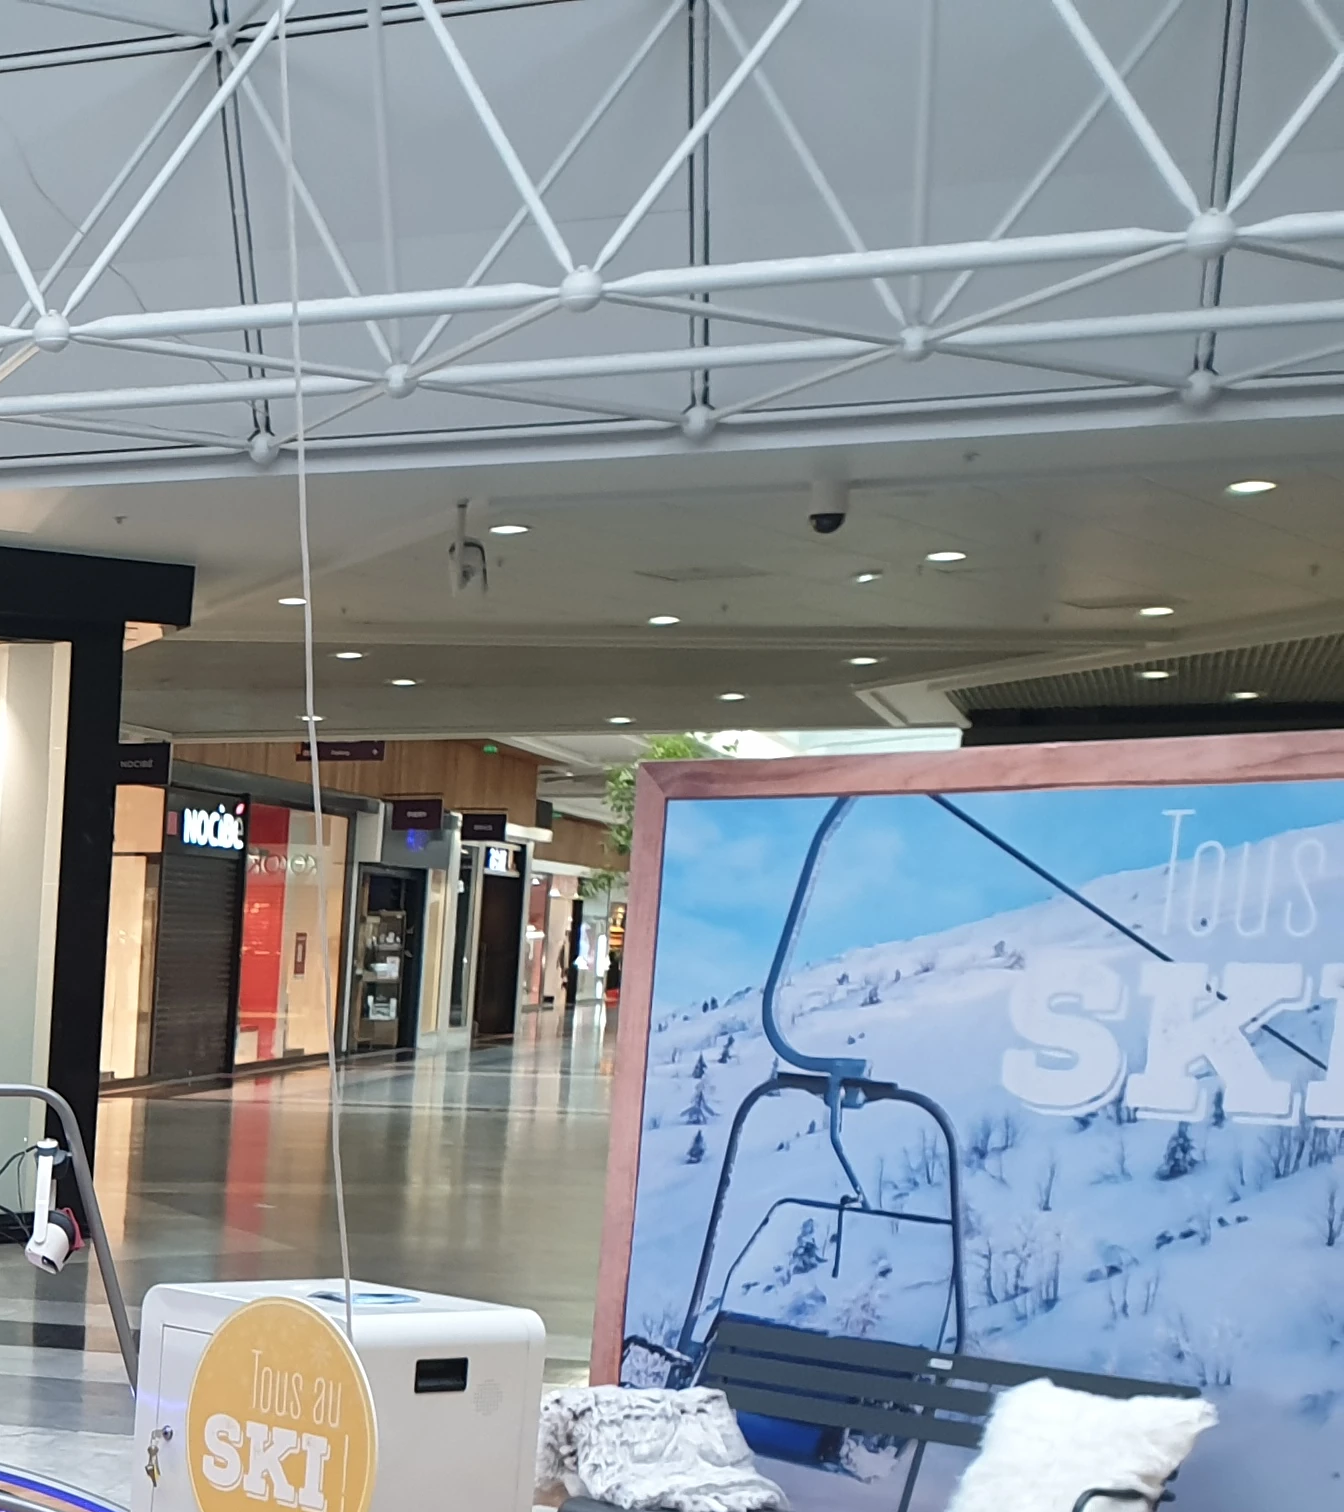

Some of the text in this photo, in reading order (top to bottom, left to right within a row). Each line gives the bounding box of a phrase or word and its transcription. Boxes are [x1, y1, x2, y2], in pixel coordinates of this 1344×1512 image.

[1162, 808, 1327, 938] Tous
[251, 1348, 342, 1429] Tous au
